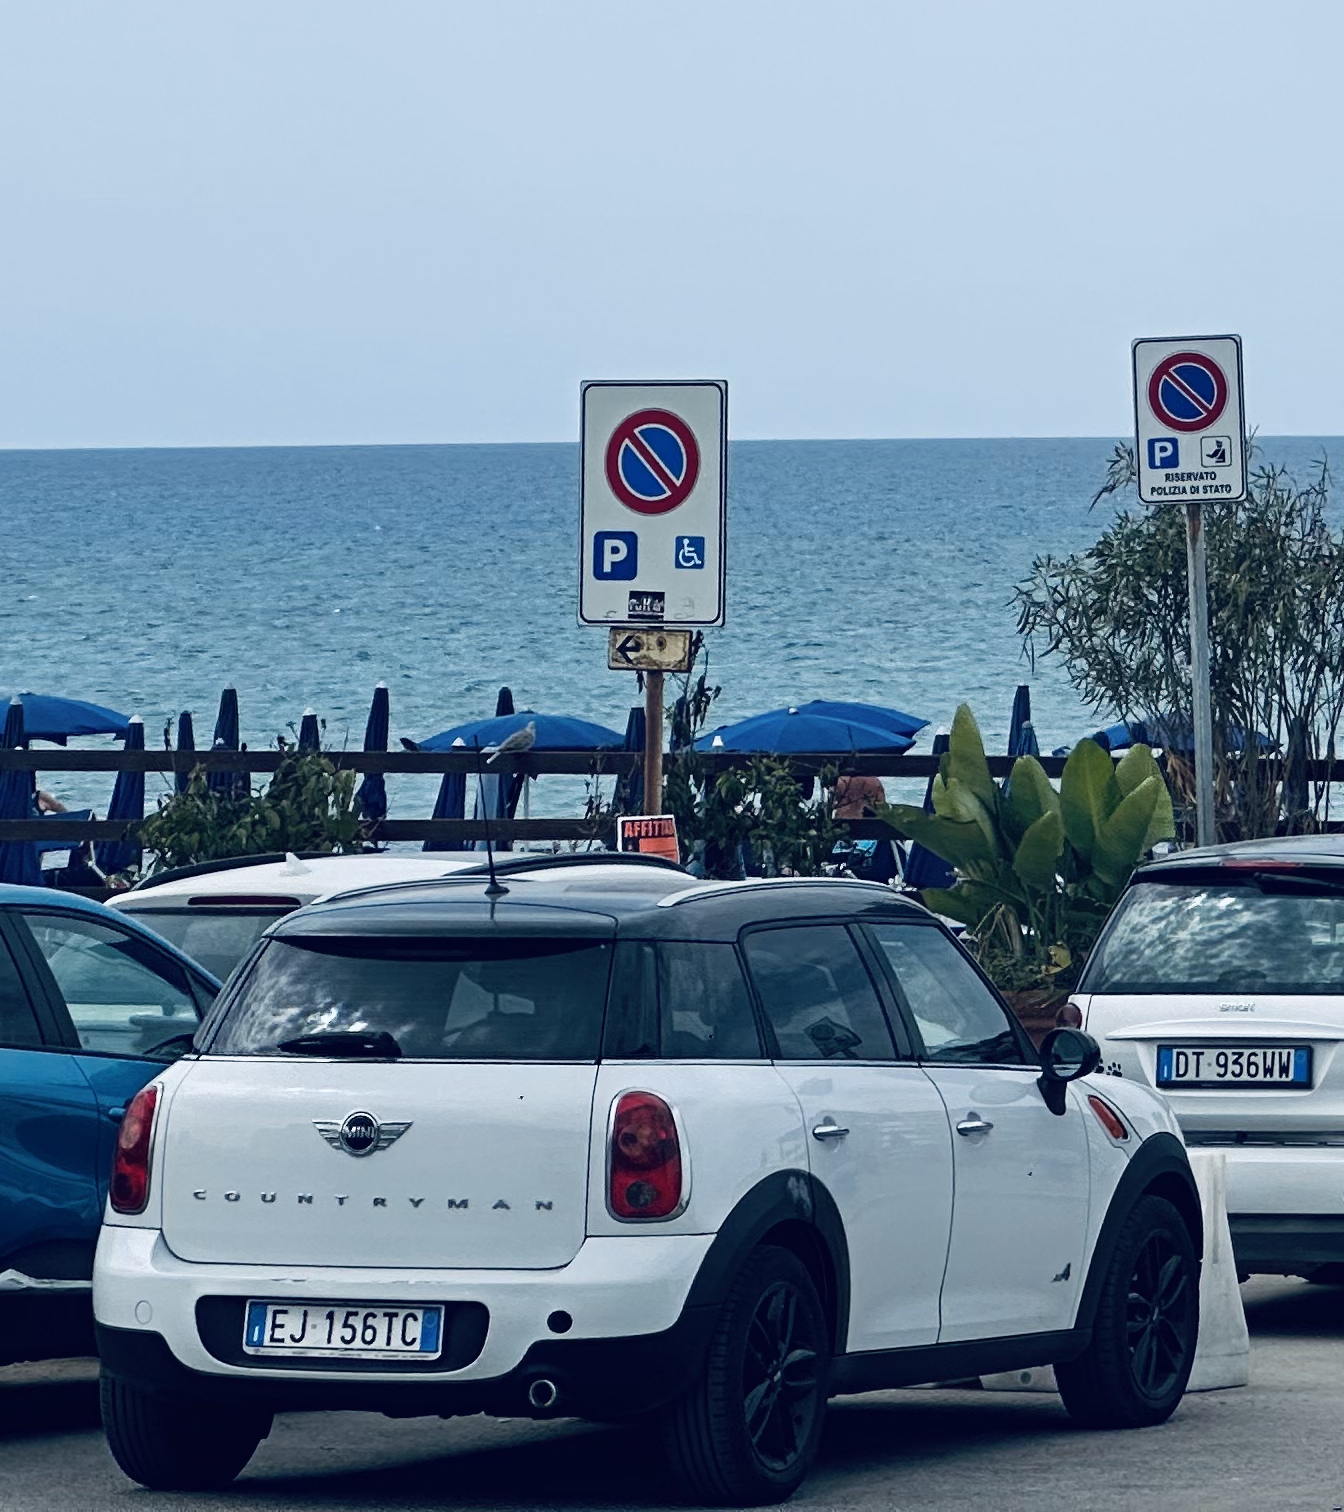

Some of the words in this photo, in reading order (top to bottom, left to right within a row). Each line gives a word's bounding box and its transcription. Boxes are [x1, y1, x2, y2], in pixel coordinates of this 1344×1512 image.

[1165, 471, 1217, 482] RISERVATO
[1150, 486, 1188, 496] POLIZIA
[1190, 485, 1200, 494] DI
[1202, 484, 1232, 494] STATO
[1176, 1051, 1205, 1078] DT
[1215, 1051, 1292, 1079] 936WW
[345, 1126, 376, 1139] MINI
[193, 1189, 553, 1211] COUNTRYMAN
[269, 1309, 308, 1344] EJ
[325, 1310, 419, 1347] 156TC
